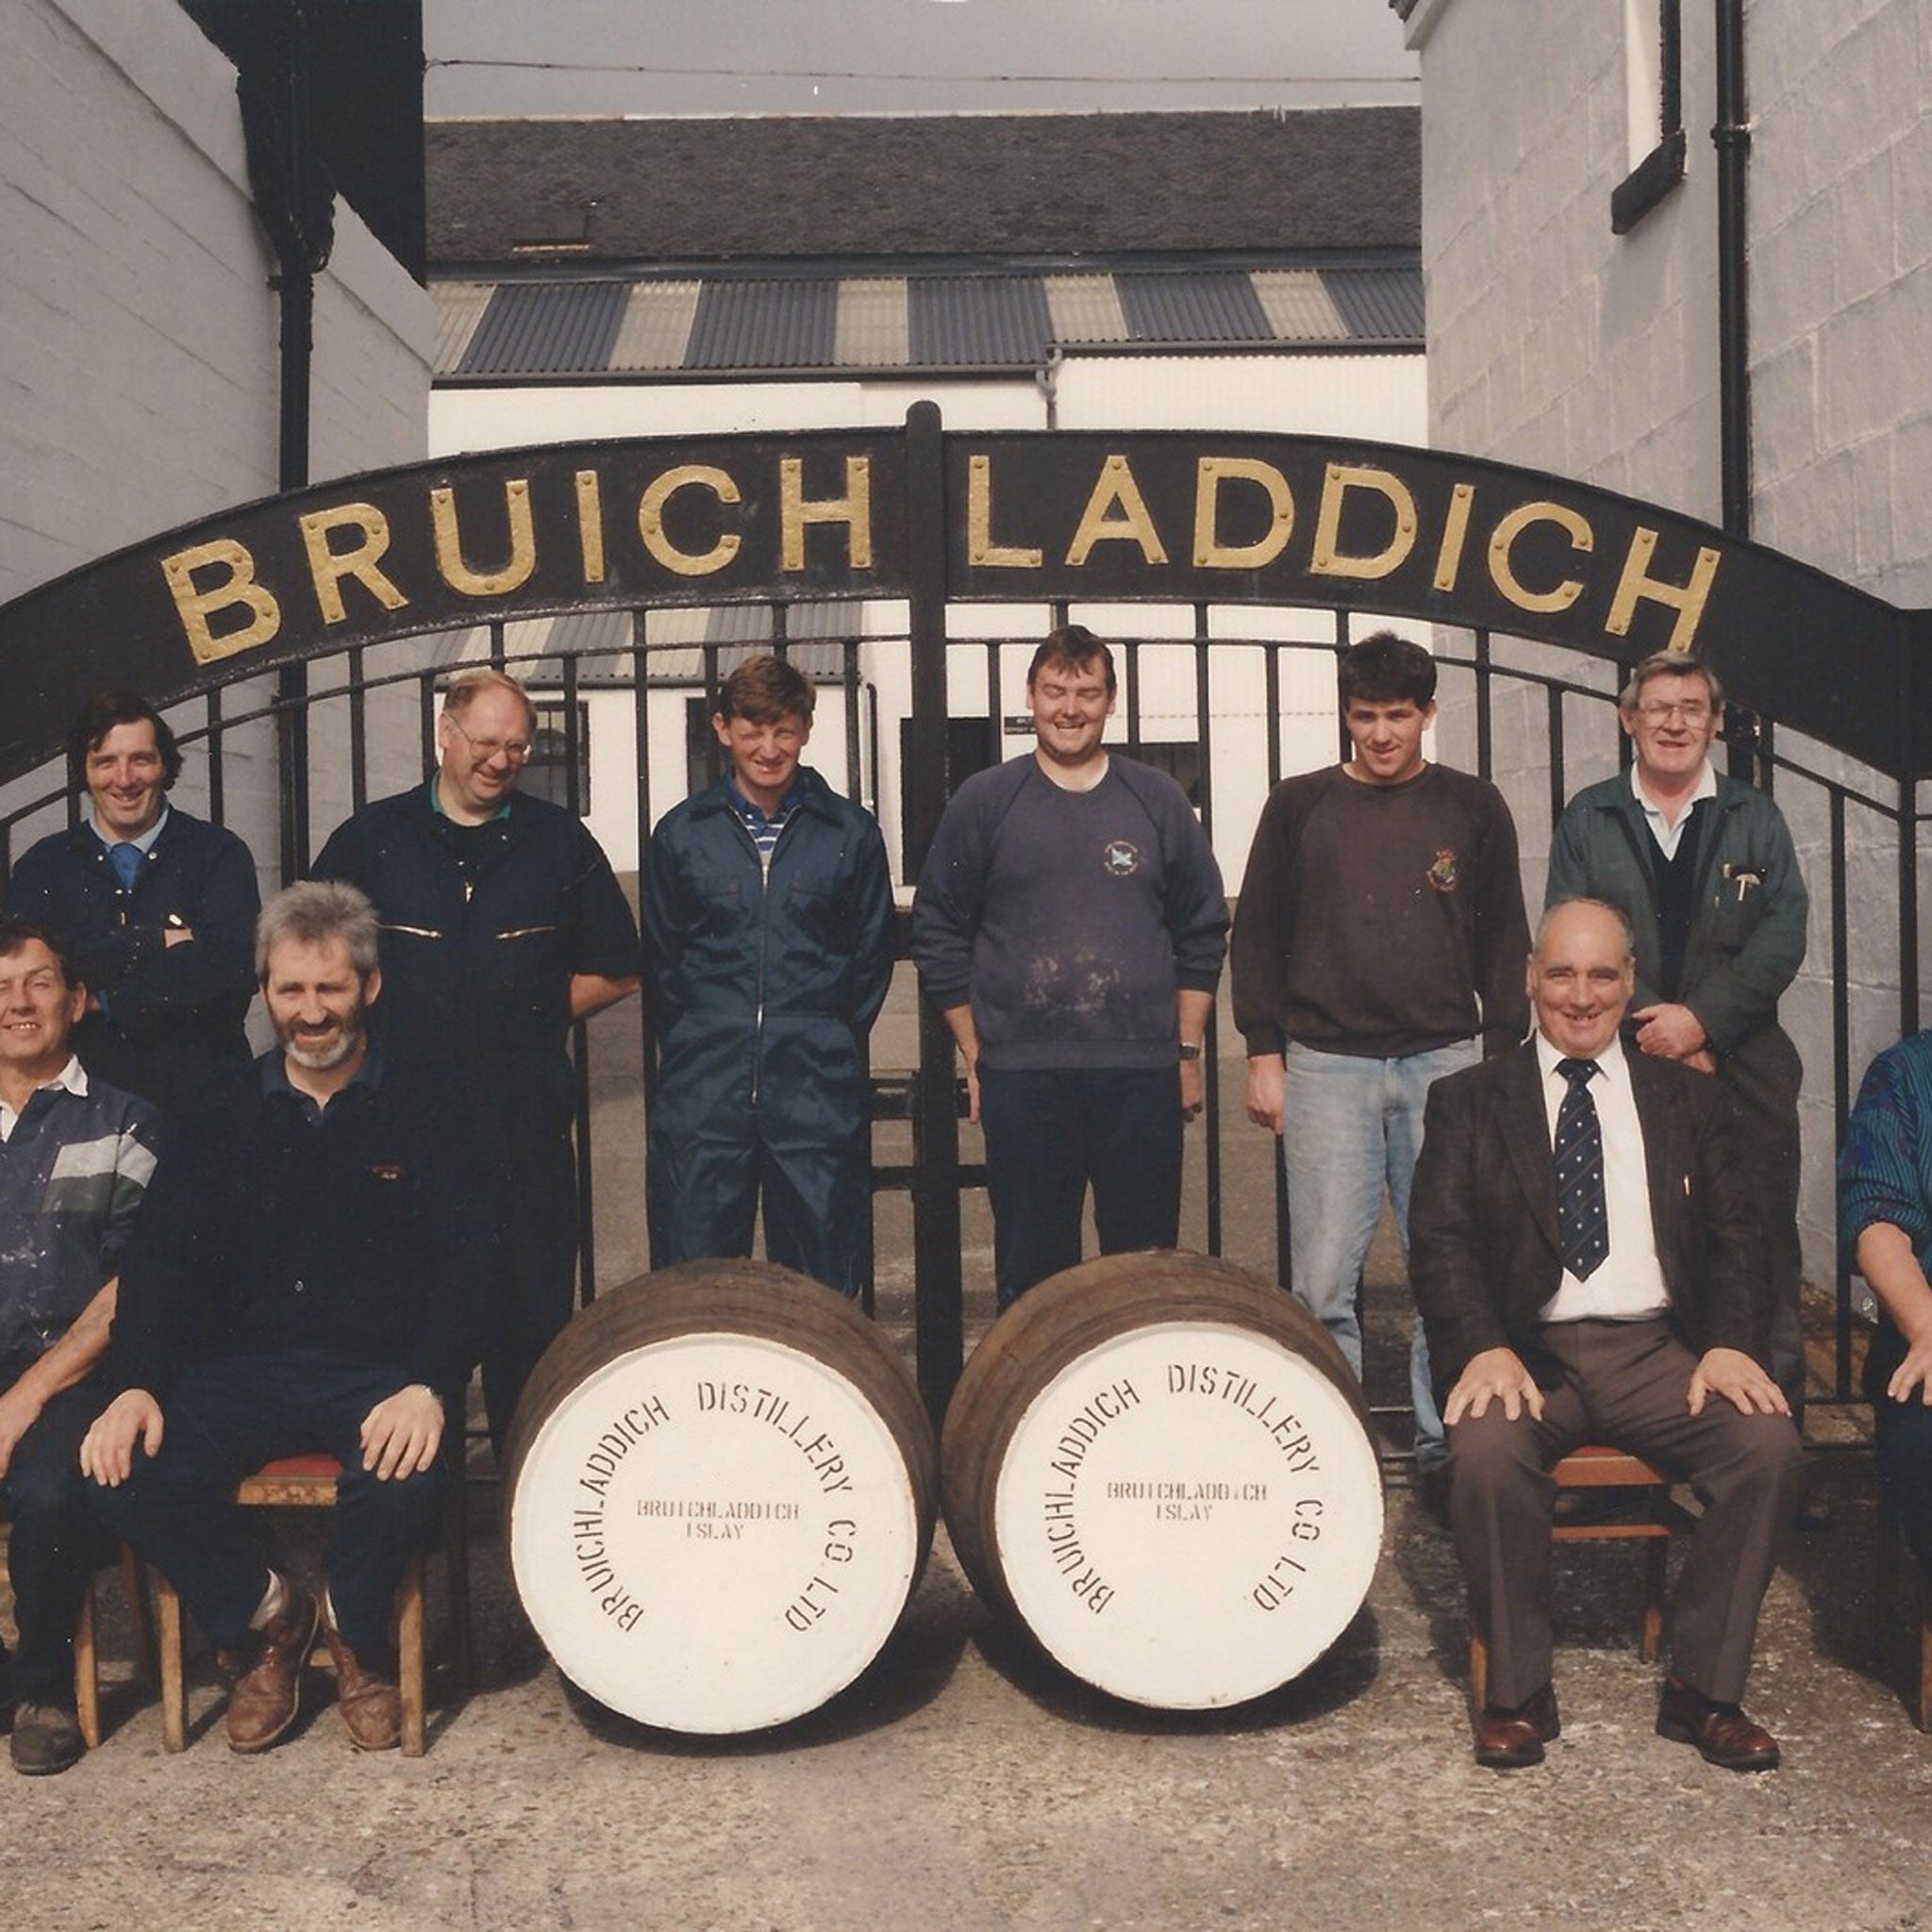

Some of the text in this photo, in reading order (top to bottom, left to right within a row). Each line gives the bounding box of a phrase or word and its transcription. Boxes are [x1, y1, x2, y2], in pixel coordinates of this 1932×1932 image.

[1044, 1379, 1141, 1614] BRUICHLADDICH
[1168, 1364, 1320, 1473] DISTILLERY
[1107, 1481, 1268, 1501] BRUICHLADDICH
[573, 1394, 670, 1632] BRUICHLADDICH
[697, 1382, 854, 1492] DISTILLERY
[636, 1498, 800, 1520] BRUICHLADDICH
[1156, 1504, 1213, 1522] ISLAY
[686, 1522, 744, 1540] ISLAY
